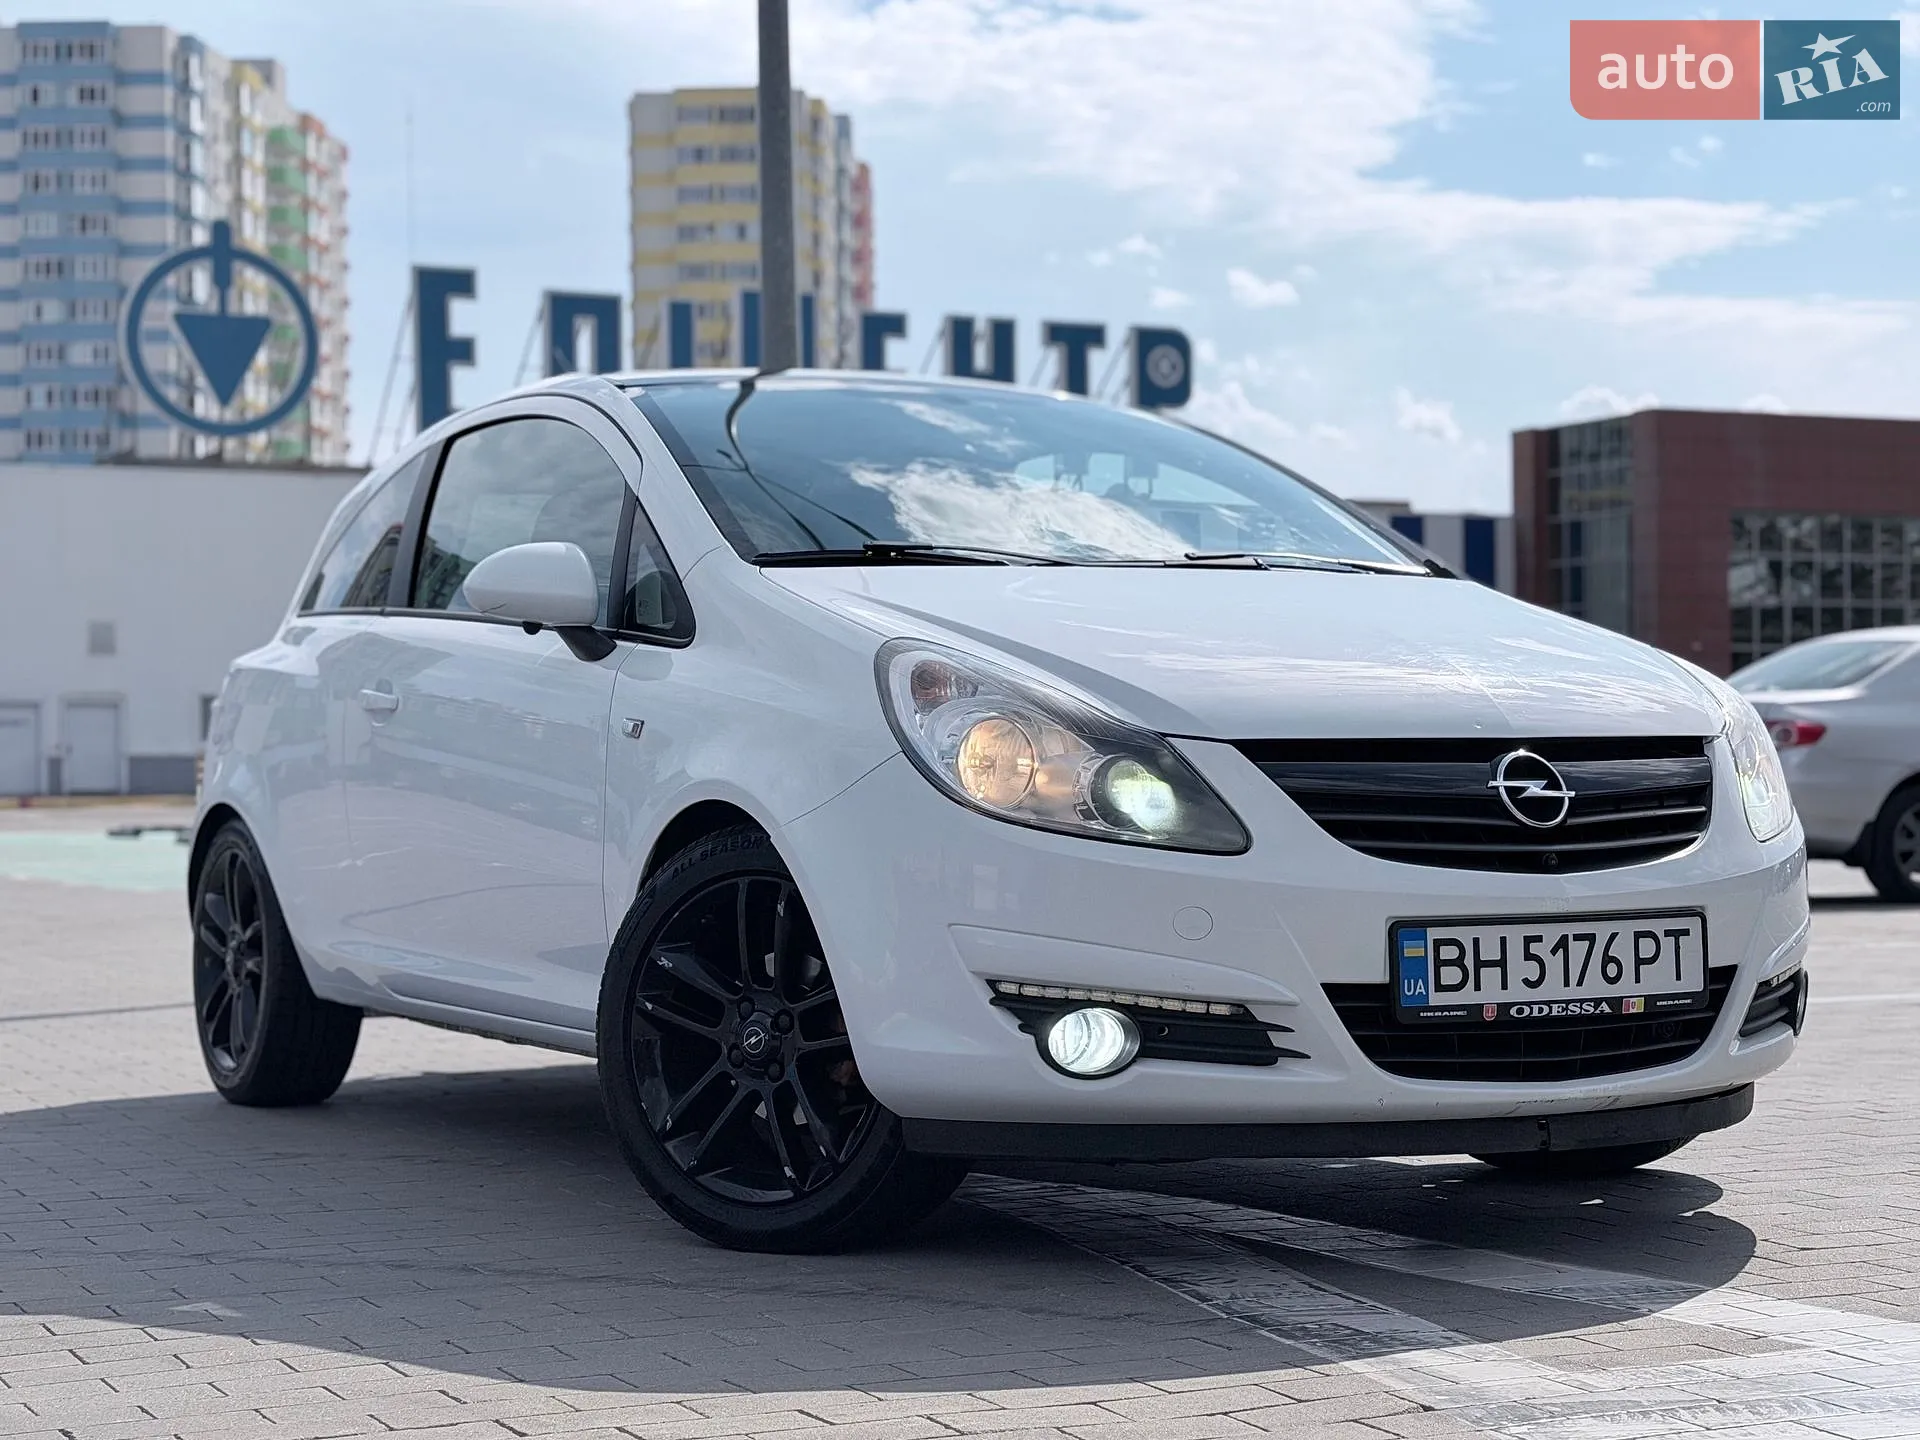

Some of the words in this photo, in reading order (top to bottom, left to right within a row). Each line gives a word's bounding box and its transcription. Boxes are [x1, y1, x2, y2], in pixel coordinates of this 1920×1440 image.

[671, 857, 696, 880] ALL
[1433, 935, 1508, 993] BH
[1521, 932, 1624, 990] 5176
[1633, 928, 1691, 985] PT
[1404, 978, 1427, 996] UA
[1509, 1001, 1613, 1018] ODESSA
